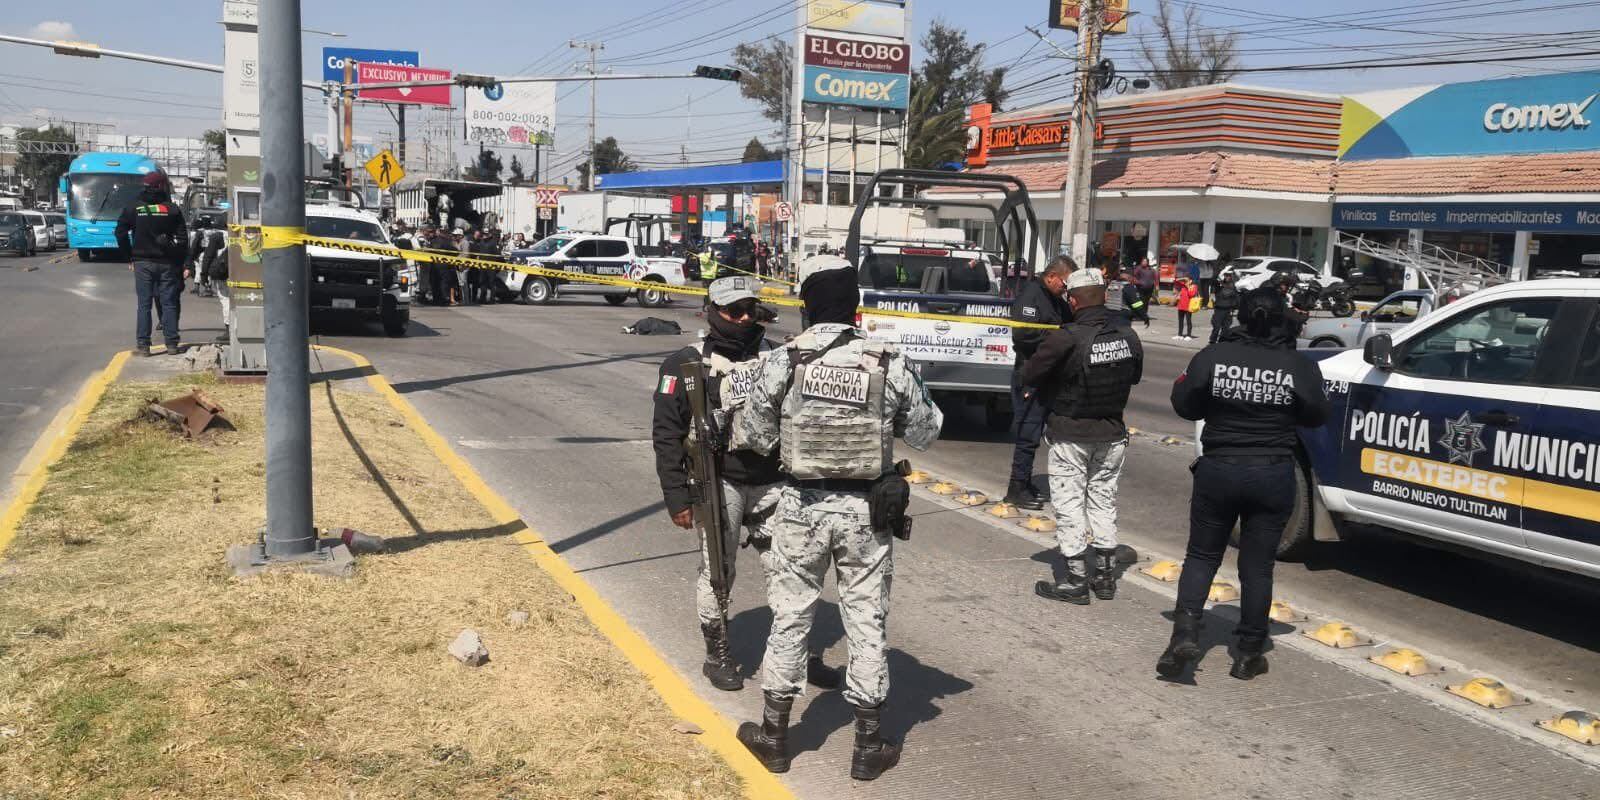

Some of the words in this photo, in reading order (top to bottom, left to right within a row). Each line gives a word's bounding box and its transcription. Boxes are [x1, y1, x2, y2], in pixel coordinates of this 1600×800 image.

[810, 38, 833, 55] EL
[835, 41, 904, 61] GLOBO
[362, 67, 407, 81] EXCLUSIVO
[815, 73, 899, 101] Comex
[1484, 93, 1600, 131] Comex
[989, 127, 1015, 148] Little
[1018, 124, 1062, 146] Caesars
[1389, 209, 1437, 222] Esmaltes
[1446, 210, 1562, 225] Impermeabilizantes
[877, 299, 920, 313] POLICÍA
[965, 303, 1011, 317] MUNICIPAL
[900, 333, 936, 346] VECINAL
[936, 335, 964, 348] Sector
[966, 337, 983, 349] 2-13
[1091, 338, 1129, 354] GUARDIA
[1089, 347, 1133, 364] NACIONAL
[811, 366, 862, 386] GUARDIA
[1214, 363, 1295, 388] POLICÍA
[803, 379, 865, 402] NACIONAL
[1212, 387, 1294, 405] ECATEPEC
[1350, 409, 1430, 454] POLICÍA
[1373, 452, 1509, 499] ECATEPEC
[1372, 480, 1410, 499] BARRIO
[1411, 488, 1448, 508] NUEVO
[1449, 496, 1508, 521] TULTITLAN
